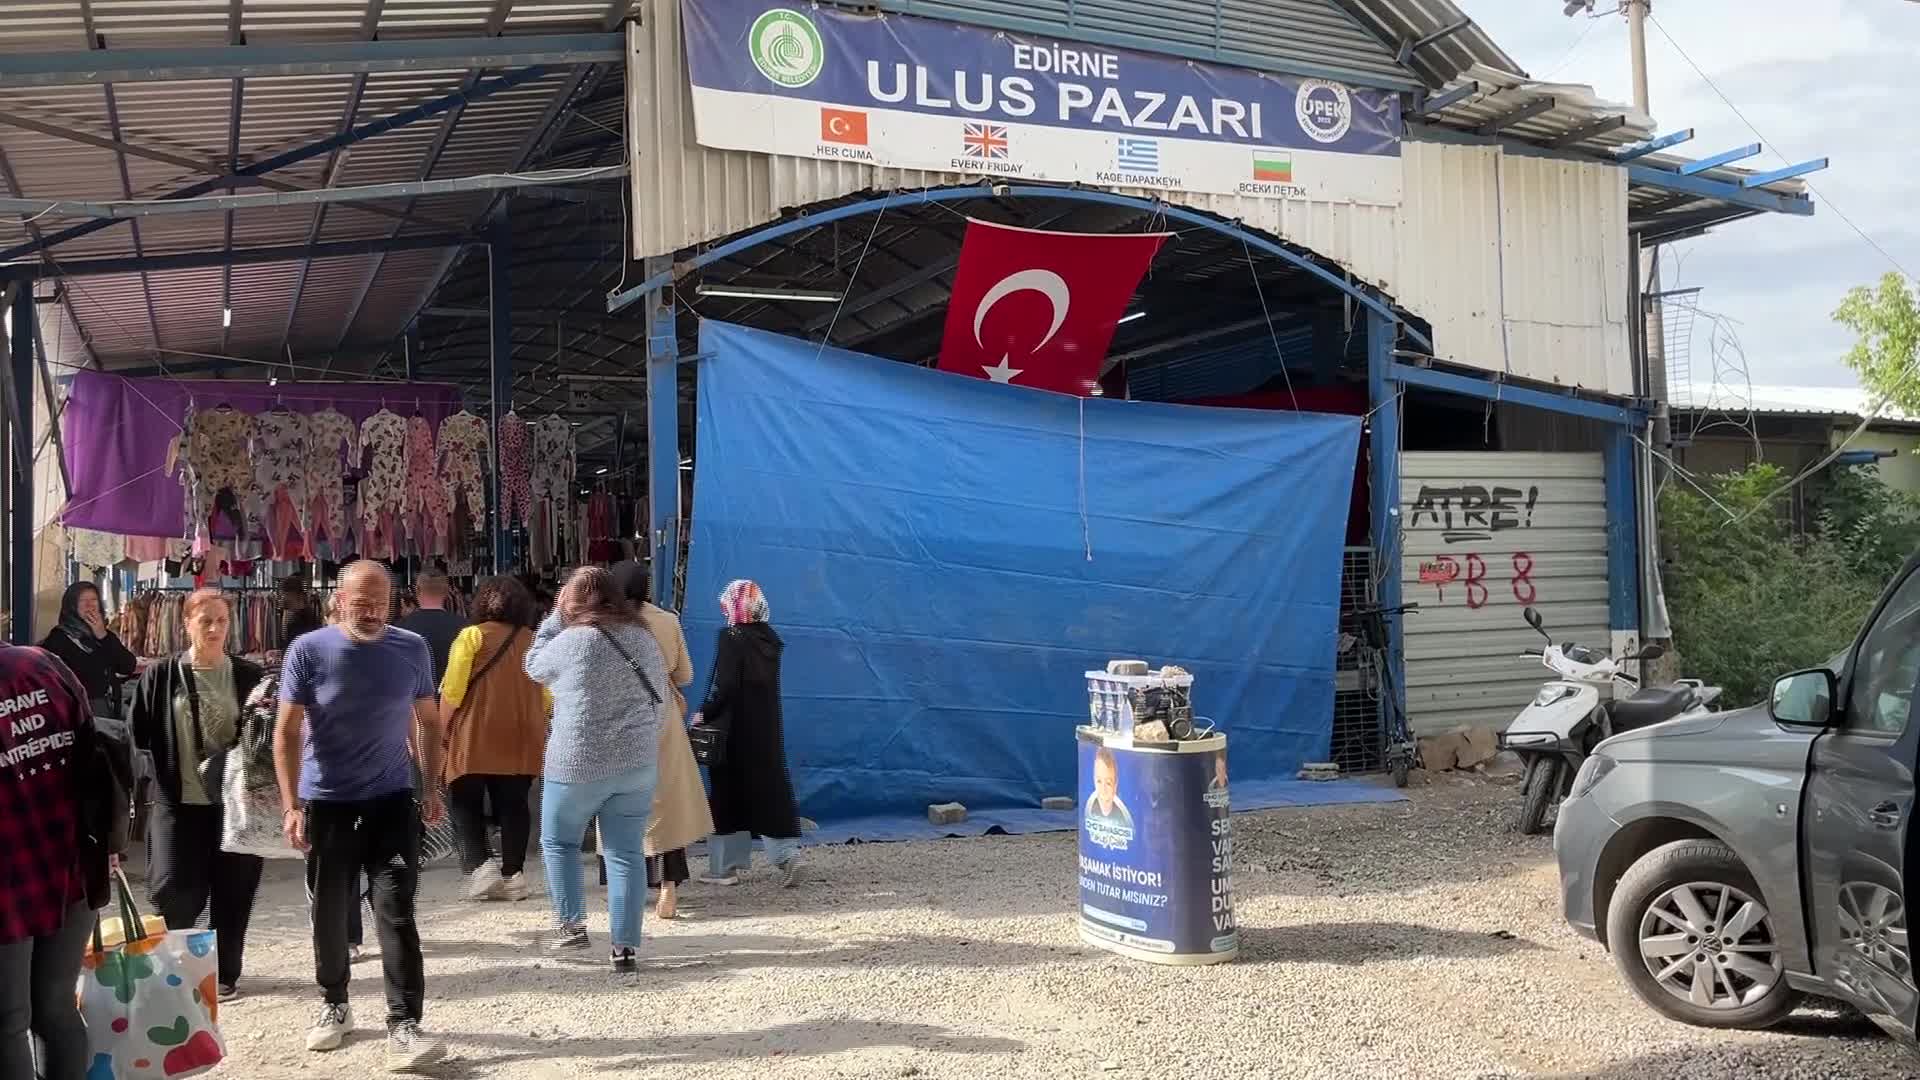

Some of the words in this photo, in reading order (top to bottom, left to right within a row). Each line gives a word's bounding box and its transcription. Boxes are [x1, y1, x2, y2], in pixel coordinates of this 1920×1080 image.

[1014, 42, 1120, 80] EDİRNE
[867, 60, 1037, 117] ULUS
[1058, 82, 1263, 138] PAZARI
[1301, 98, 1346, 118] UPEK
[816, 145, 839, 156] HER
[841, 148, 873, 160] CUMA
[951, 158, 984, 170] EVERY
[987, 162, 1023, 174] FRIDAY
[1096, 172, 1123, 183] ΚΑΘΕ
[1239, 183, 1271, 193] ВСЕКИ
[1273, 185, 1306, 197] ПЕТЪК
[1411, 486, 1538, 531] ATRE!
[1512, 551, 1536, 606] 8
[0, 689, 49, 718] BRAVE
[10, 713, 46, 738] AND
[0, 730, 76, 768] INTRÉPIDE
[1211, 818, 1231, 836] SE
[1212, 855, 1231, 872] SA
[1112, 861, 1162, 888] İSTİYOR!
[1097, 881, 1120, 900] TUTAR
[1211, 876, 1231, 895] UM
[1212, 894, 1231, 912] DU
